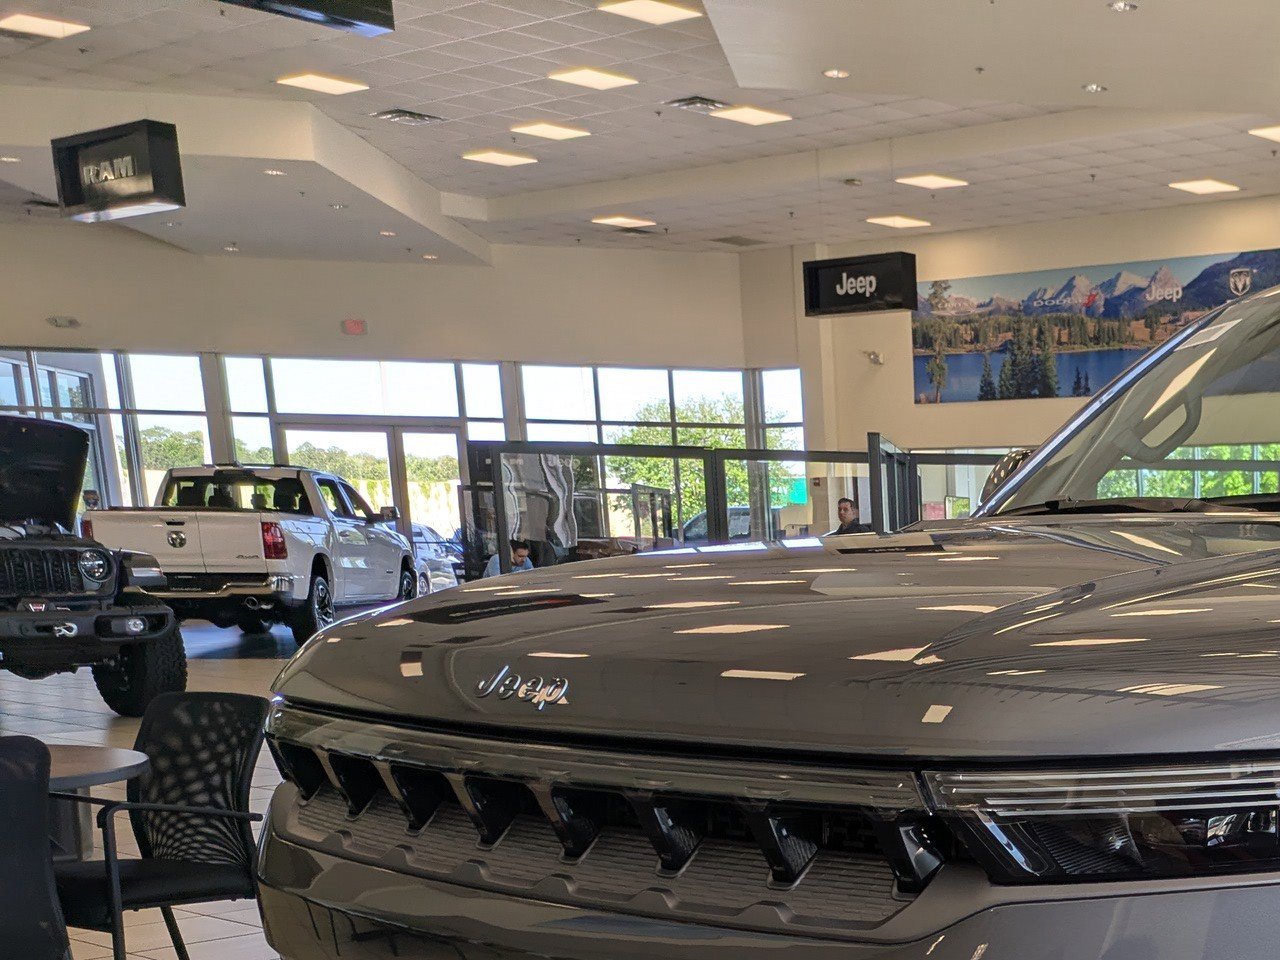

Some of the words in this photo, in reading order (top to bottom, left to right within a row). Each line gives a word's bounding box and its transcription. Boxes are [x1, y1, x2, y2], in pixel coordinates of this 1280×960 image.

[83, 156, 133, 184] RAM
[835, 272, 876, 297] Jeep
[1146, 285, 1182, 302] Jeep
[1033, 297, 1081, 308] DOD
[475, 665, 567, 711] Jeep
